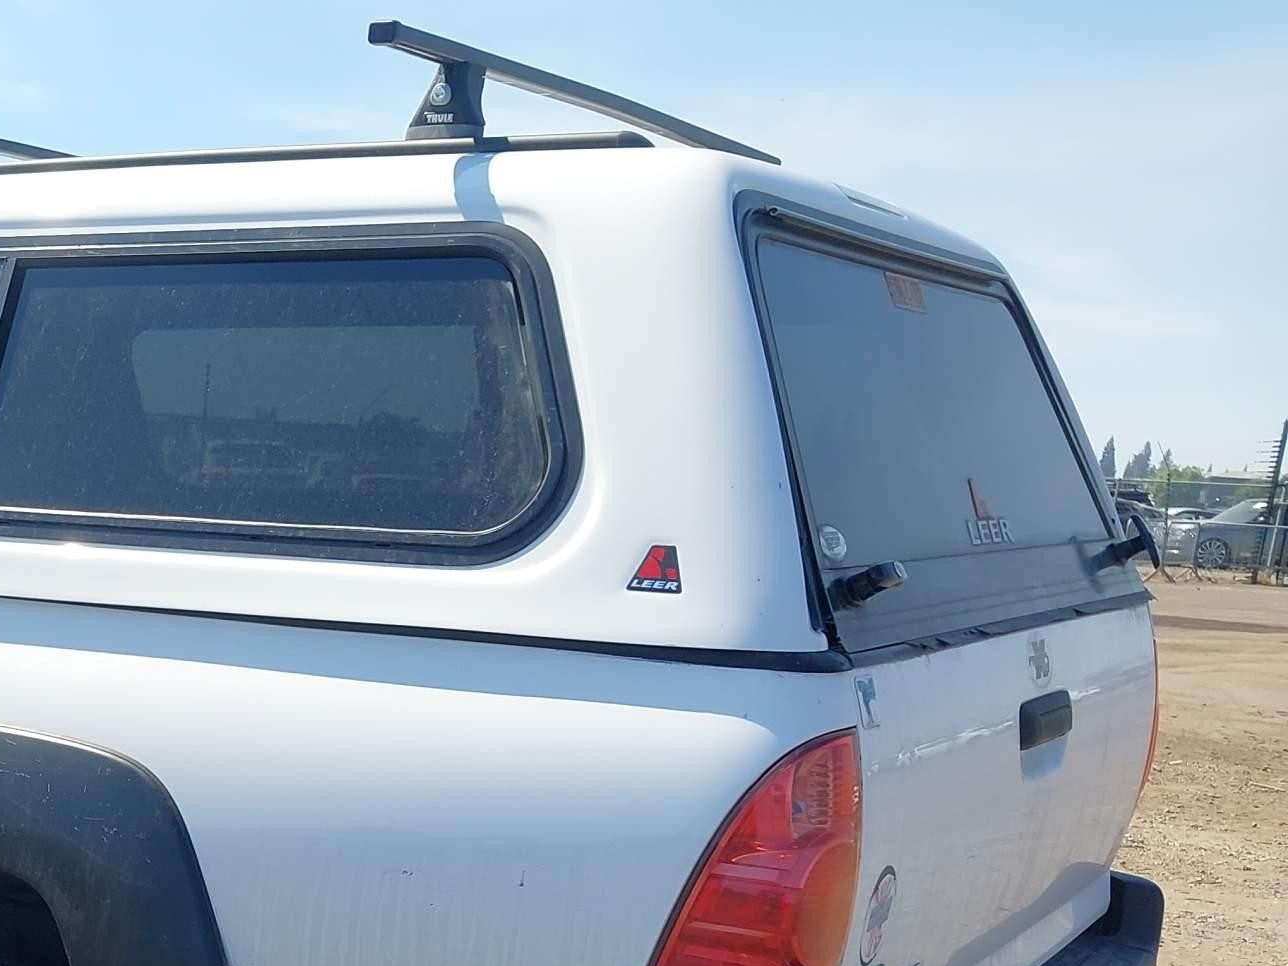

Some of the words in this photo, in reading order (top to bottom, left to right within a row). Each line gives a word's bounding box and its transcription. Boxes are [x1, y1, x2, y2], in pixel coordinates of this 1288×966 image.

[425, 112, 454, 123] THULE
[967, 518, 1014, 545] LEER
[630, 578, 680, 591] LEER
